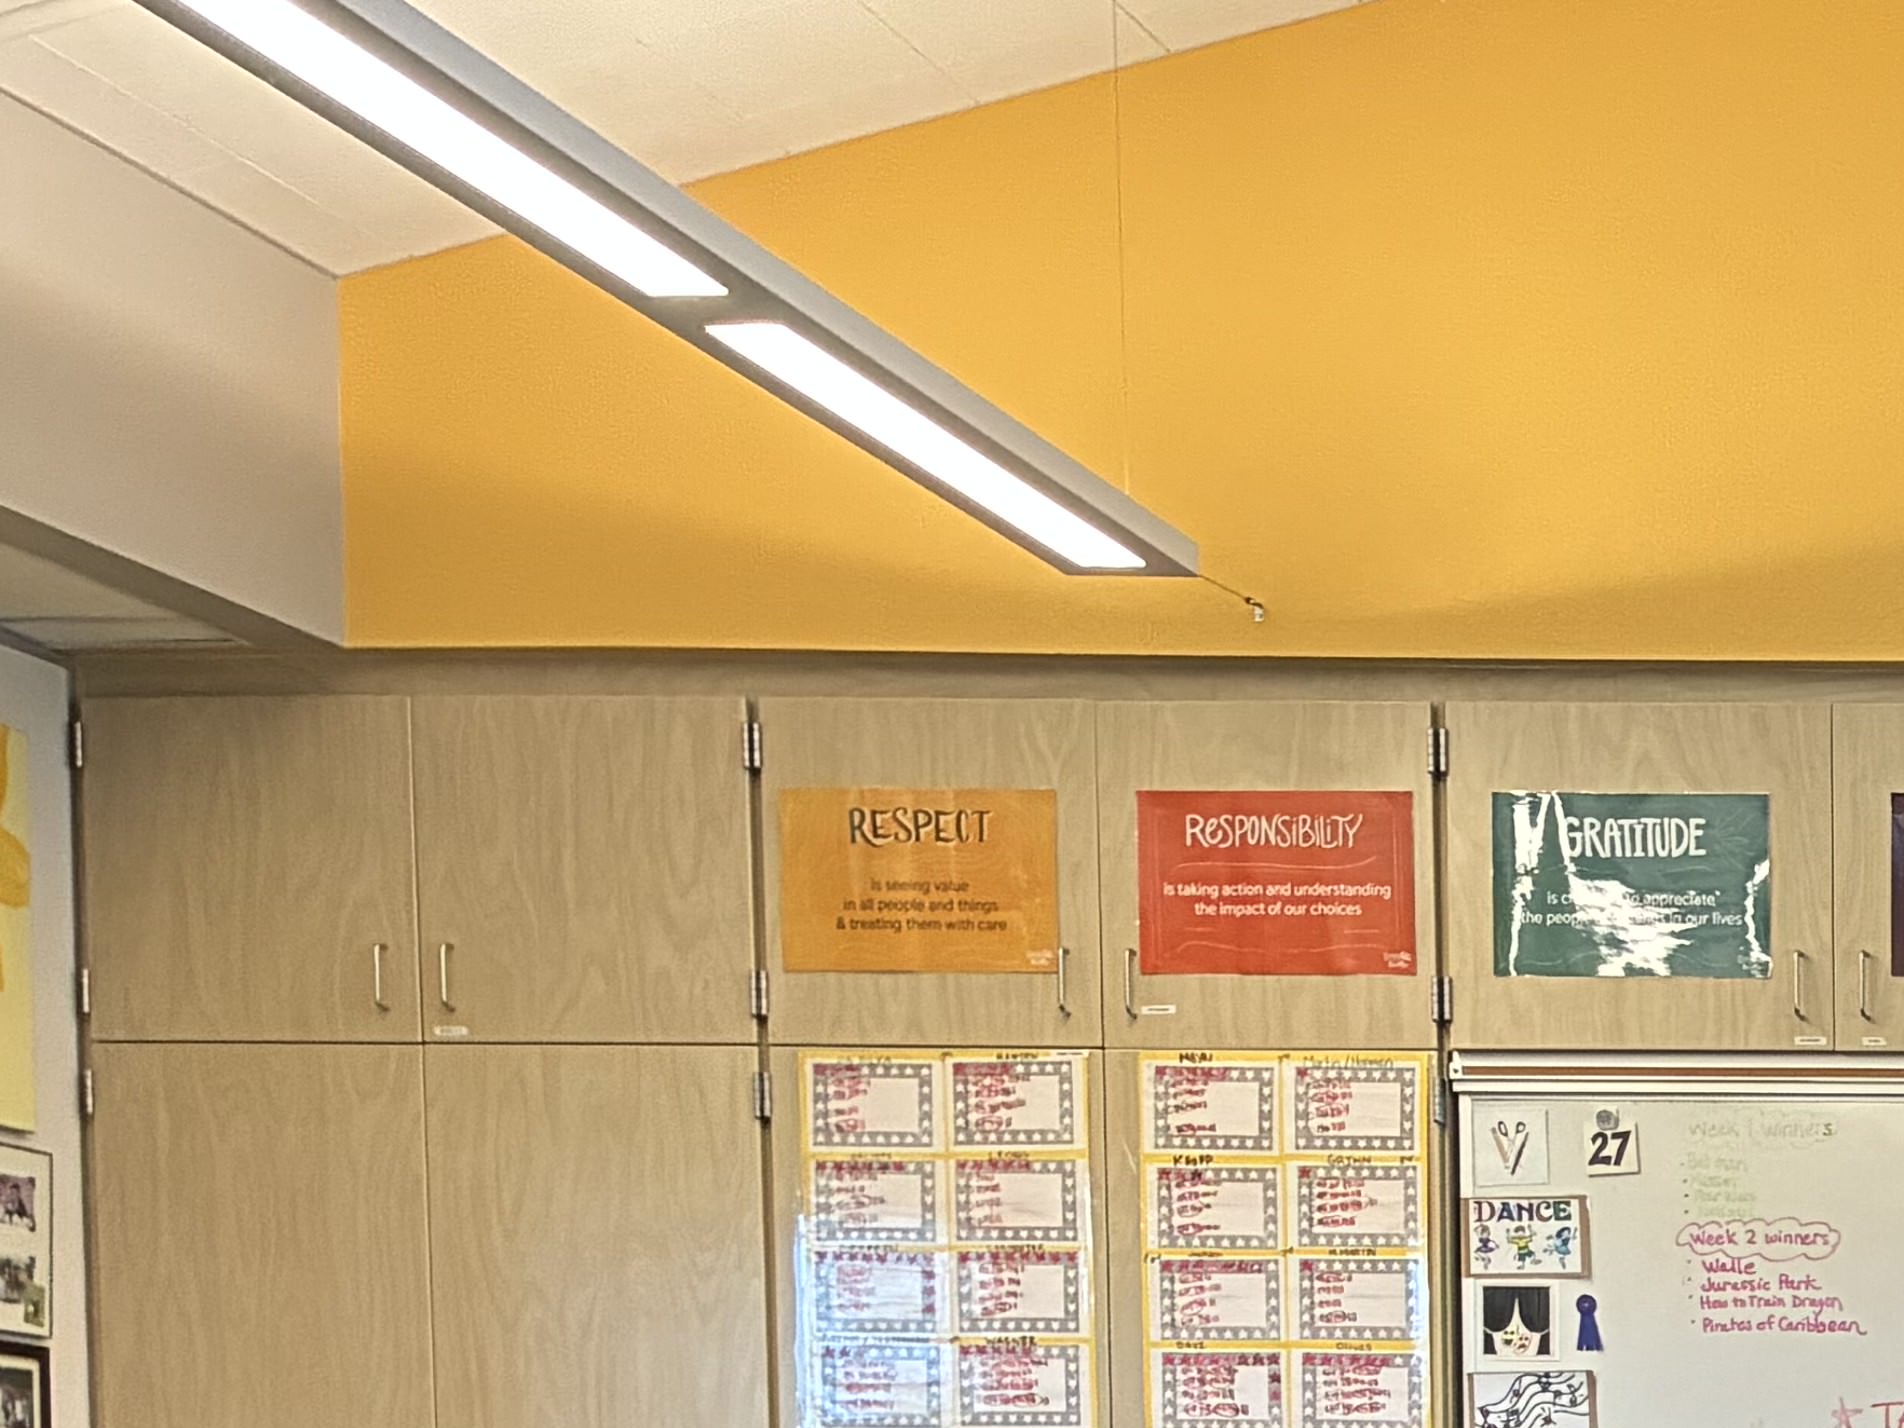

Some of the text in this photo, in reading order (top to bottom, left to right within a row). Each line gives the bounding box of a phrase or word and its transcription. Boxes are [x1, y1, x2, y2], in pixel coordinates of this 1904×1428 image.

[848, 806, 993, 846] RESPECT
[1164, 883, 1391, 899] is taking action and understanding
[1195, 901, 1362, 917] the impact of our choices
[1588, 1130, 1632, 1167] 27
[1473, 1200, 1573, 1223] DANCE
[1746, 1229, 1757, 1246] 2
[1764, 1232, 1831, 1247] winners
